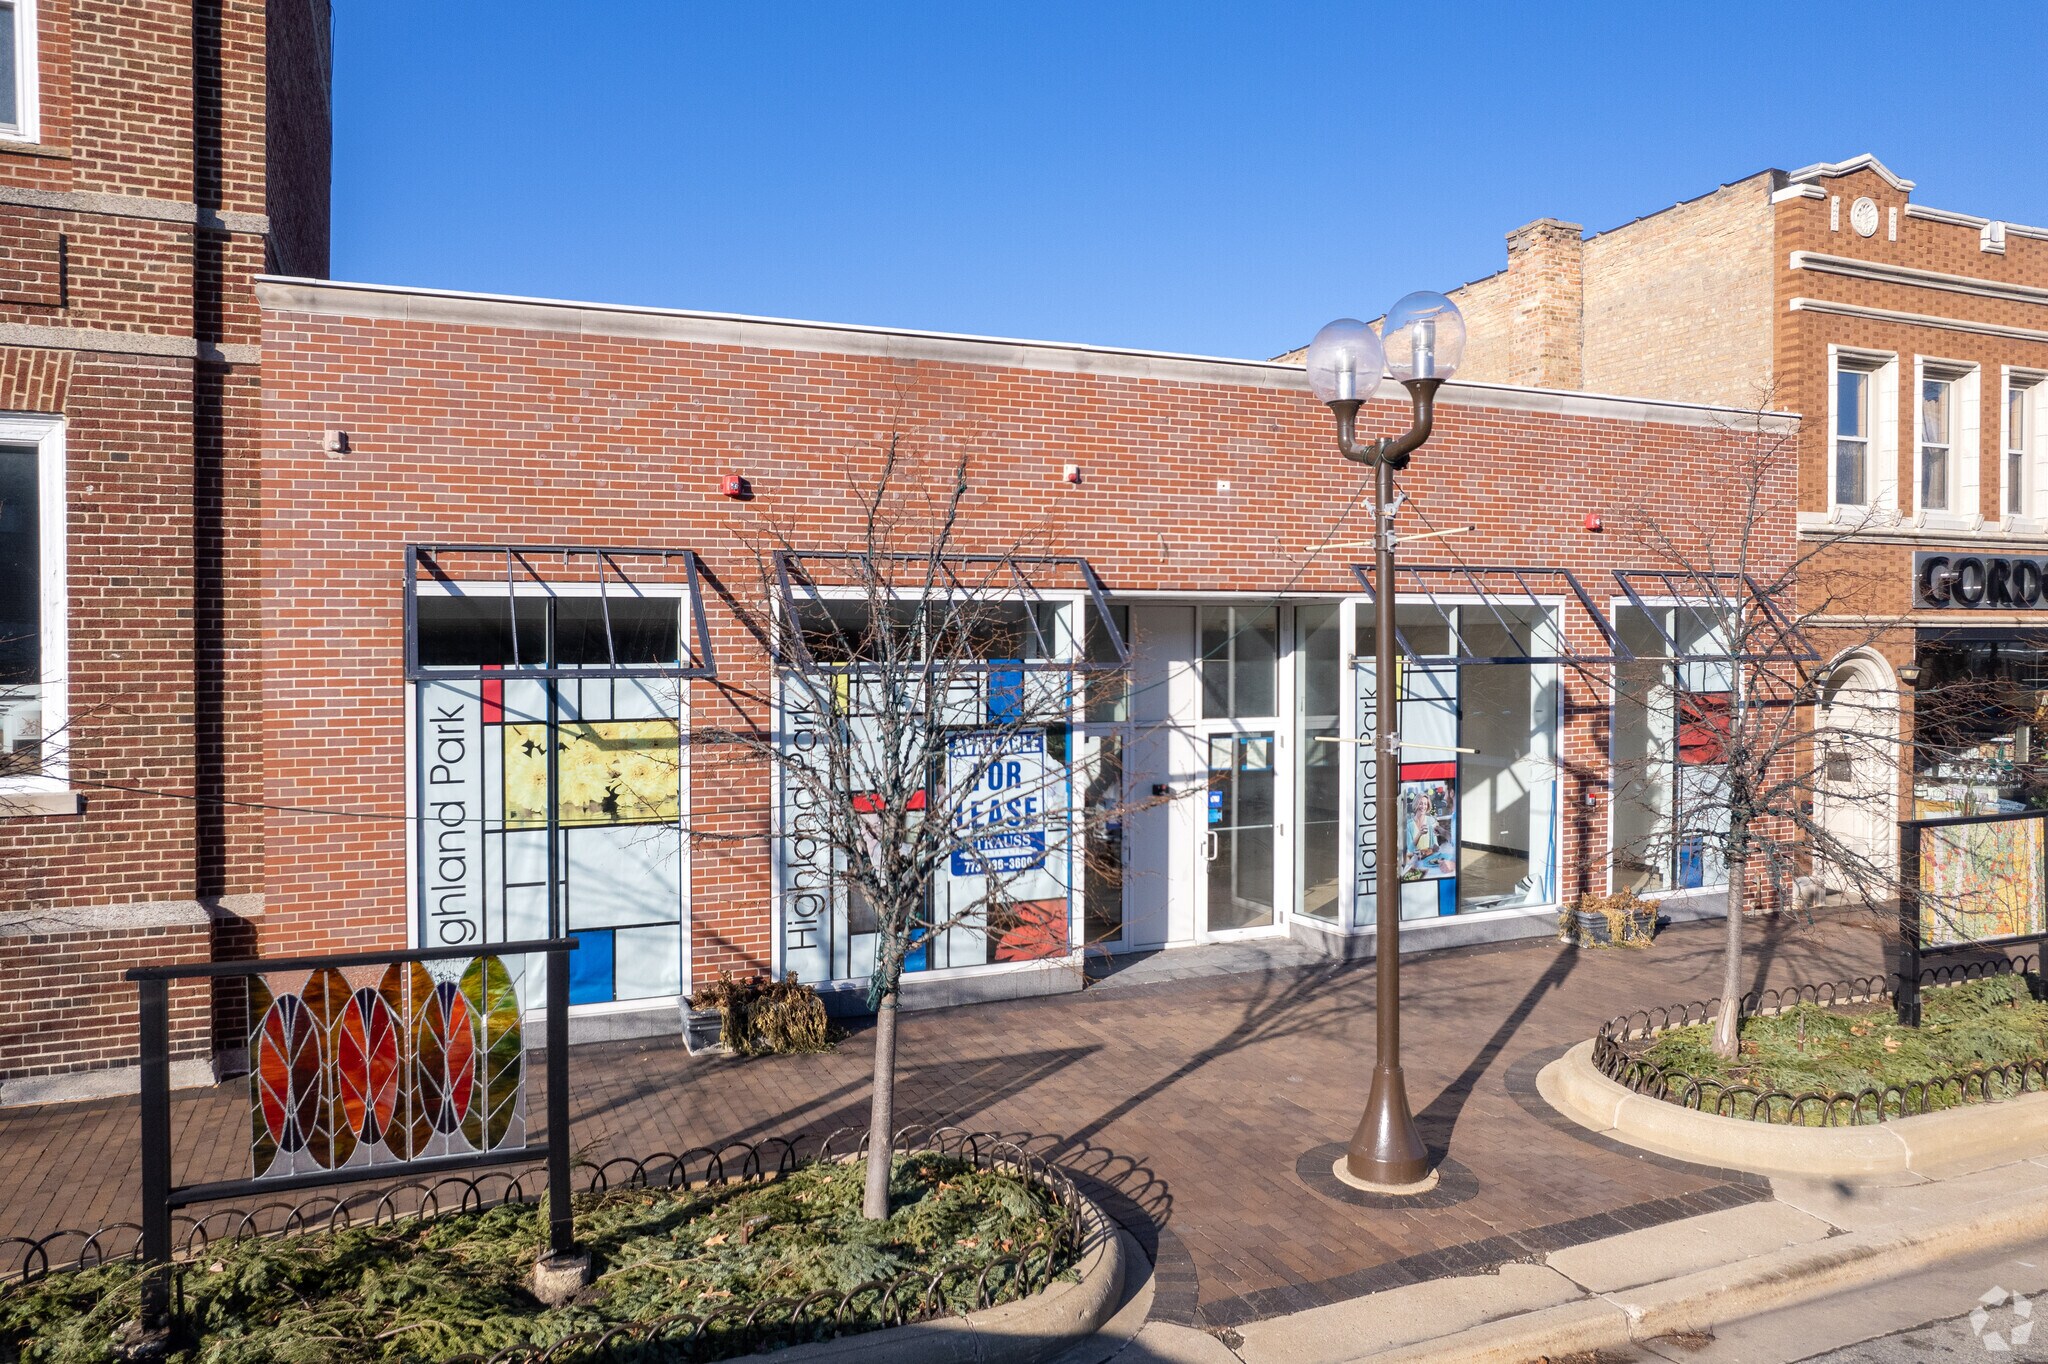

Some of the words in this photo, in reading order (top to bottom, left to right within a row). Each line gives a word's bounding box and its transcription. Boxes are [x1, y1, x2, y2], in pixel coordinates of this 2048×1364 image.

[1919, 556, 2048, 608] GORD
[429, 703, 466, 785] Park
[1359, 688, 1377, 748] Park
[964, 856, 1034, 874] 77336-3600
[969, 834, 1031, 850] TRAUSS
[430, 801, 477, 945] ghland
